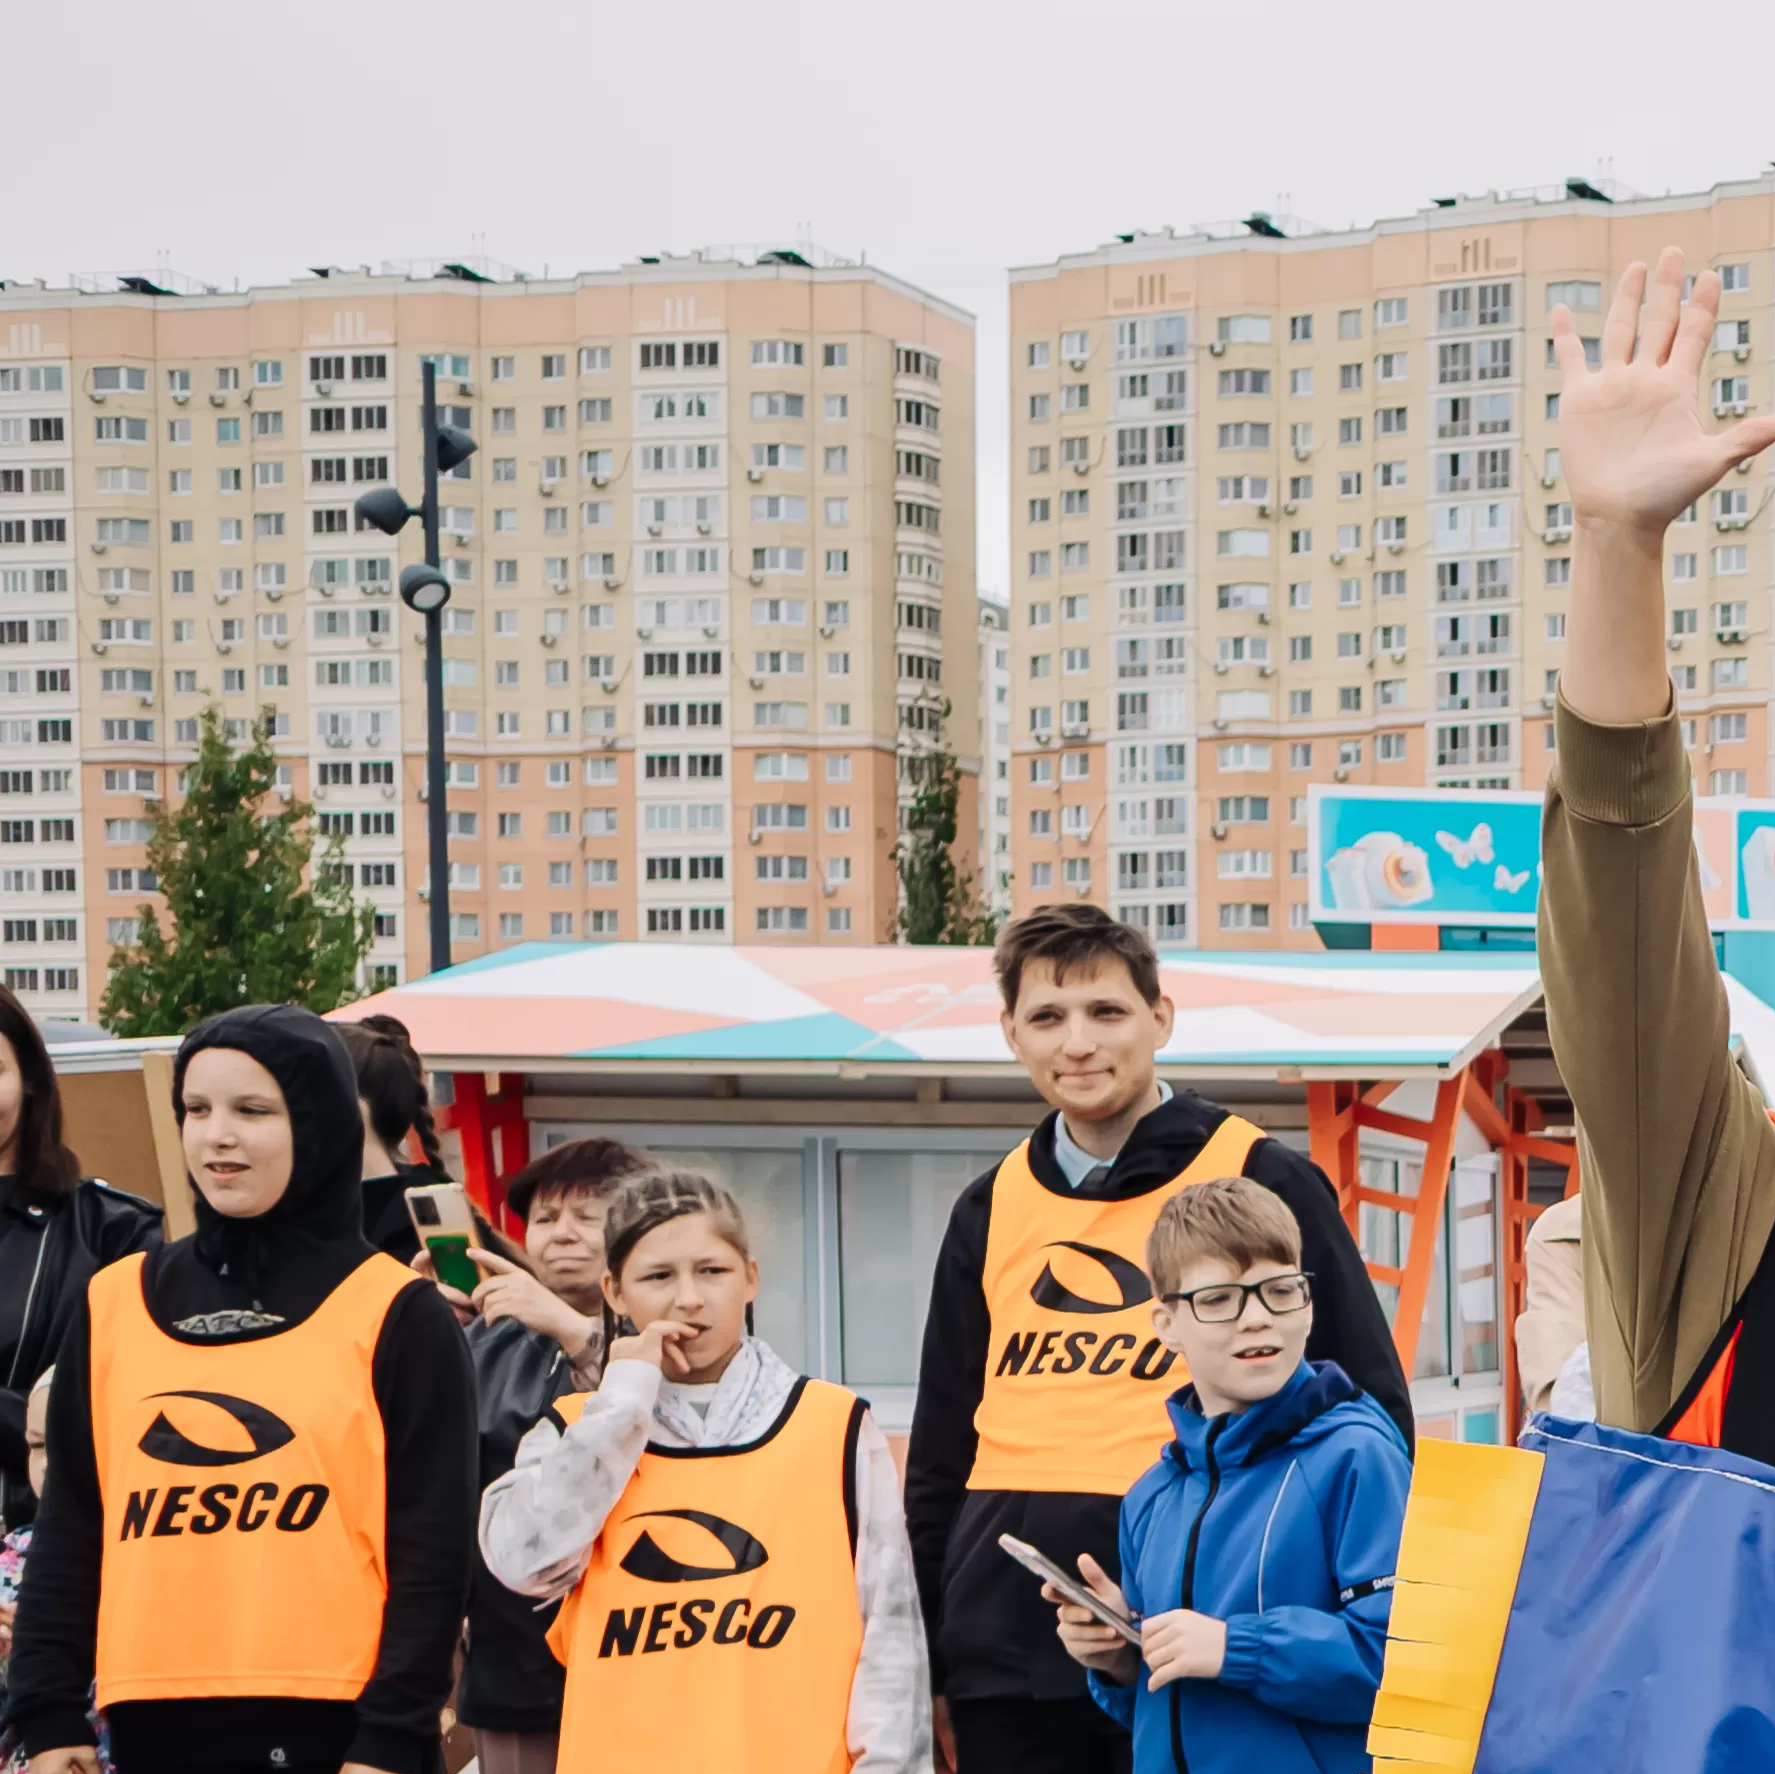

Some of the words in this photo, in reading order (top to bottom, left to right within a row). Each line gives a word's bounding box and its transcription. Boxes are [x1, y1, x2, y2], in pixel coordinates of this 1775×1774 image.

[995, 1331, 1178, 1380] NESCO
[120, 1482, 329, 1541] NESCO
[597, 1598, 796, 1659] NESCO
